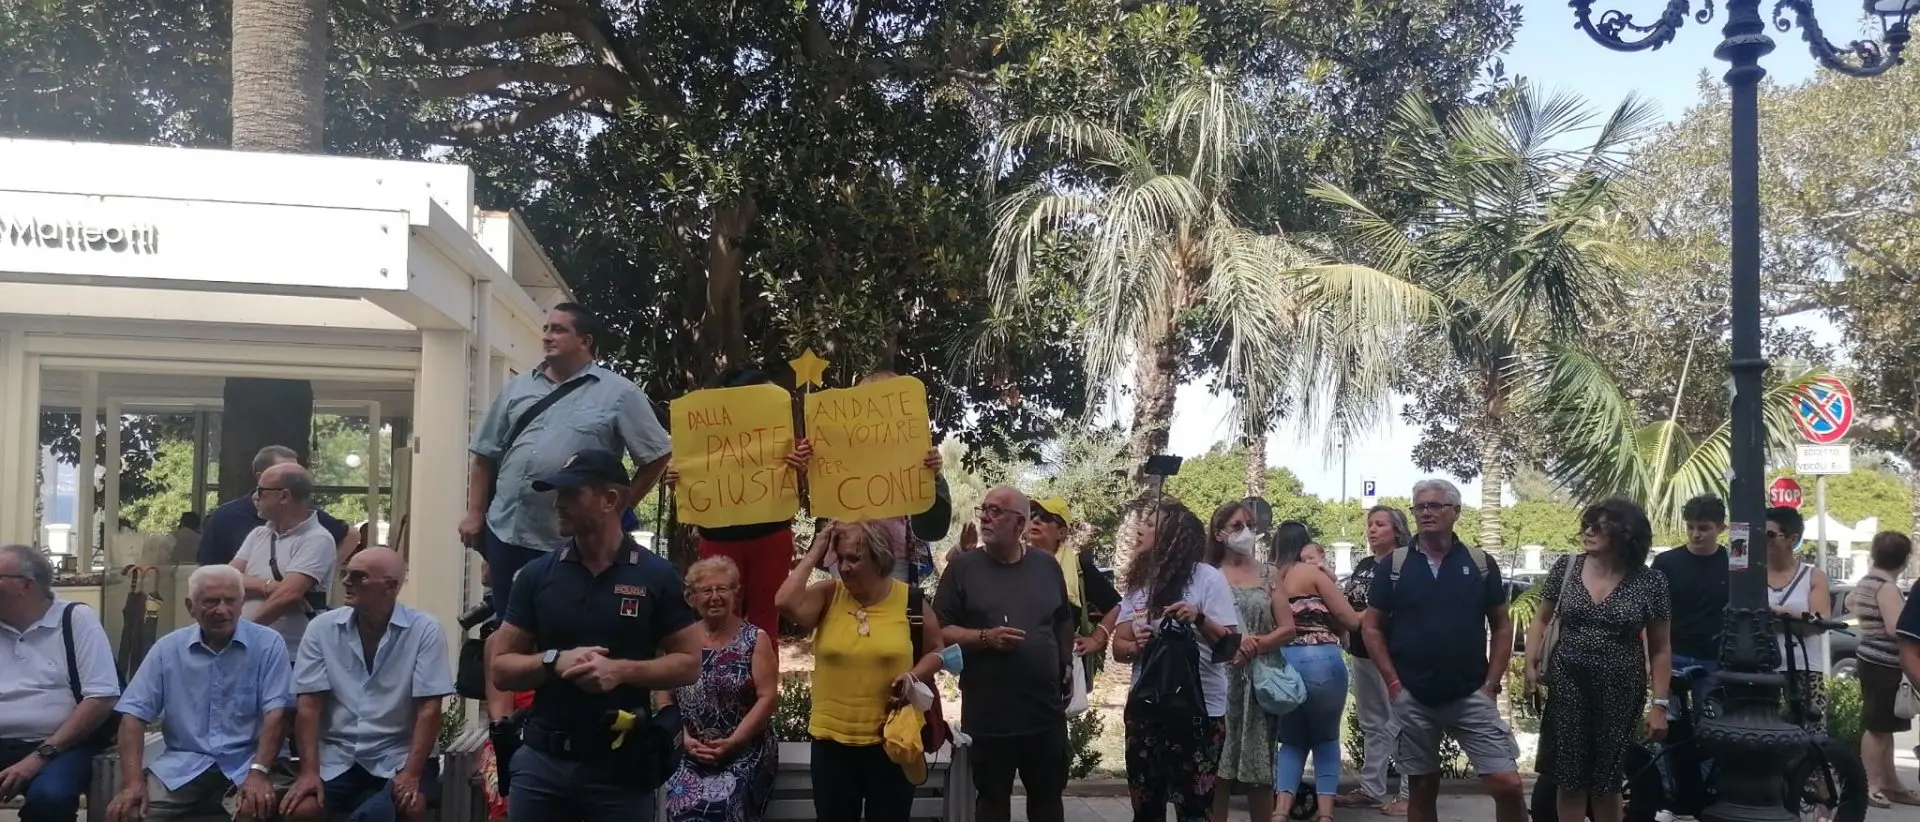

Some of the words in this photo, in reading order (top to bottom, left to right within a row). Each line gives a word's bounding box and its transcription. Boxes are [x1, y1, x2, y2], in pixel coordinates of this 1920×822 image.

[9, 213, 159, 254] Matteotti
[687, 405, 733, 430] DALLA
[812, 391, 913, 422] ANDATE
[813, 425, 832, 448] A
[842, 417, 921, 448] VOTARE
[706, 425, 787, 473] PARTE
[816, 457, 850, 478] PER
[687, 464, 801, 513] GIUSTA
[837, 464, 934, 511] CONTE
[1365, 482, 1374, 495] P
[1770, 488, 1802, 503] STOP
